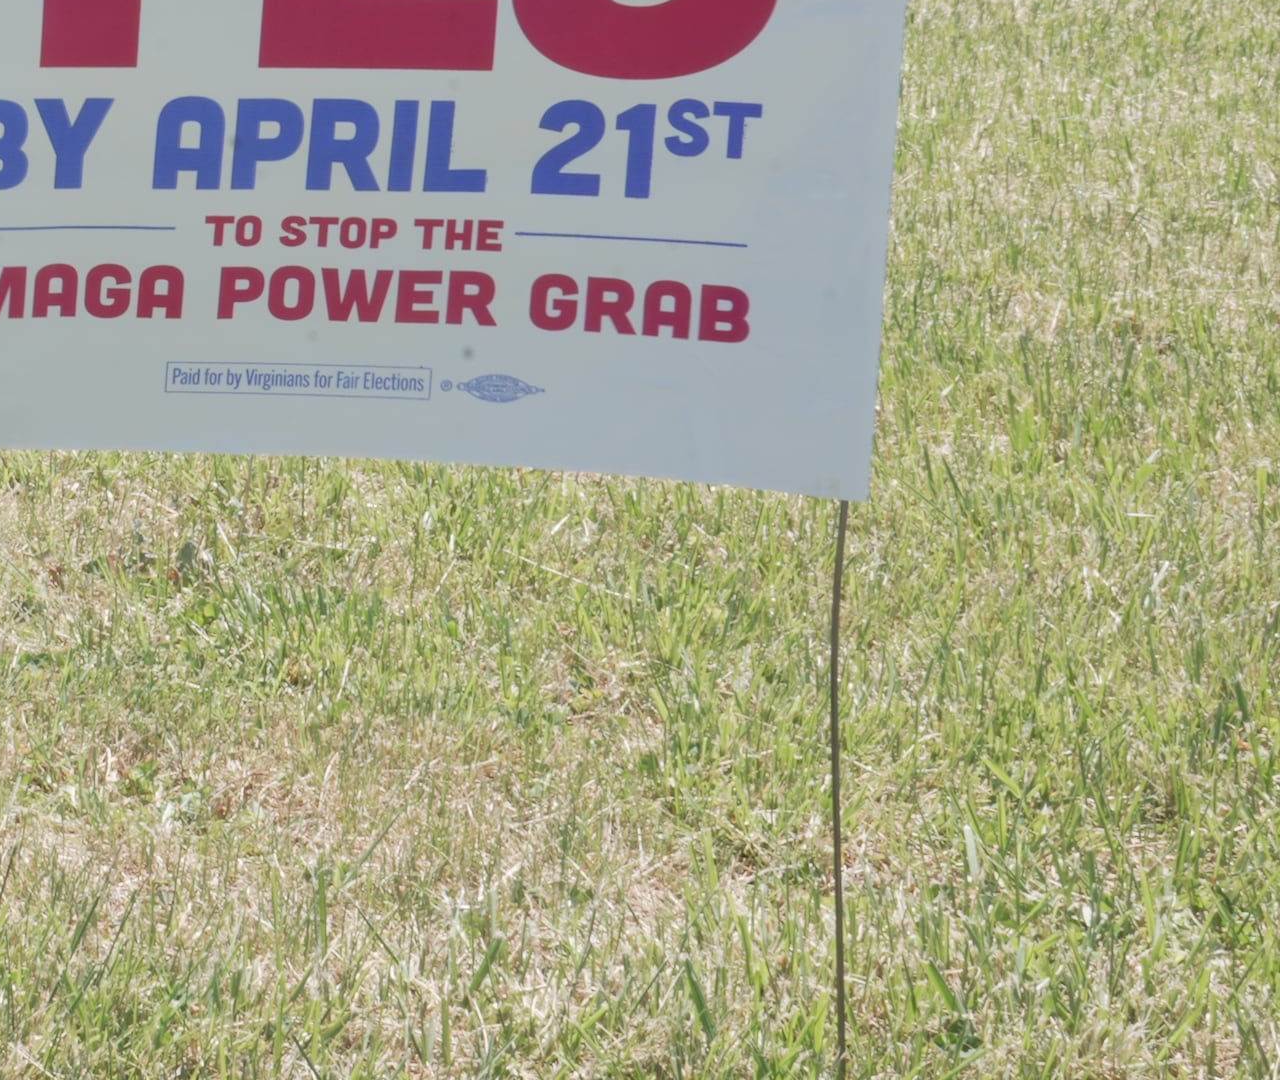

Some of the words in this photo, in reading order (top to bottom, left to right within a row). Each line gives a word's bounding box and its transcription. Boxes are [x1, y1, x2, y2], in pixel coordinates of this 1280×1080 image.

[152, 96, 488, 193] APRIL
[530, 98, 763, 199] 21ST
[205, 215, 262, 247] TO
[280, 215, 397, 250] STOP
[414, 218, 504, 252] THE
[217, 264, 498, 327] POWER
[528, 274, 751, 343] GRAB
[172, 367, 200, 386] Paid
[204, 367, 223, 386] for
[226, 368, 242, 390] by
[246, 368, 310, 392] Virginians
[314, 370, 333, 388] for
[336, 371, 360, 390] Fair
[364, 371, 424, 392] Elections
